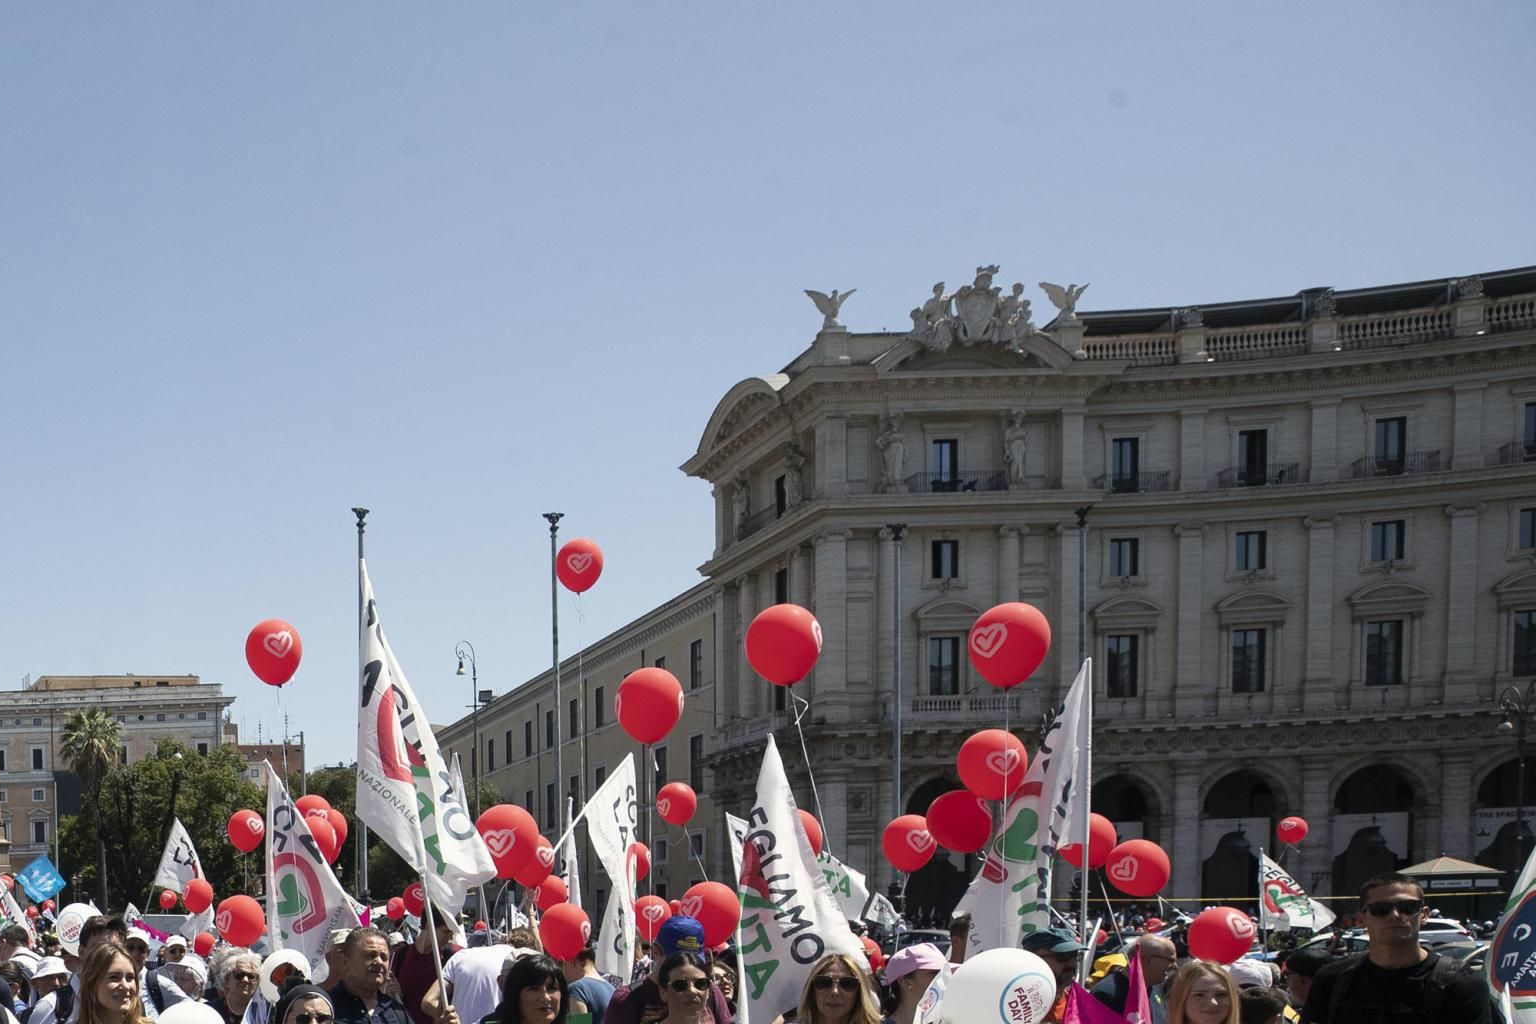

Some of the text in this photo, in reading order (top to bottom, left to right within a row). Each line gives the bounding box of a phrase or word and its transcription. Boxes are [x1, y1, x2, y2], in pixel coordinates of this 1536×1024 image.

[358, 771, 418, 825] NAZIONALE
[747, 806, 825, 965] EGLIAMO
[1008, 999, 1023, 1022] DAY
[1014, 986, 1033, 1024] FAMILY
